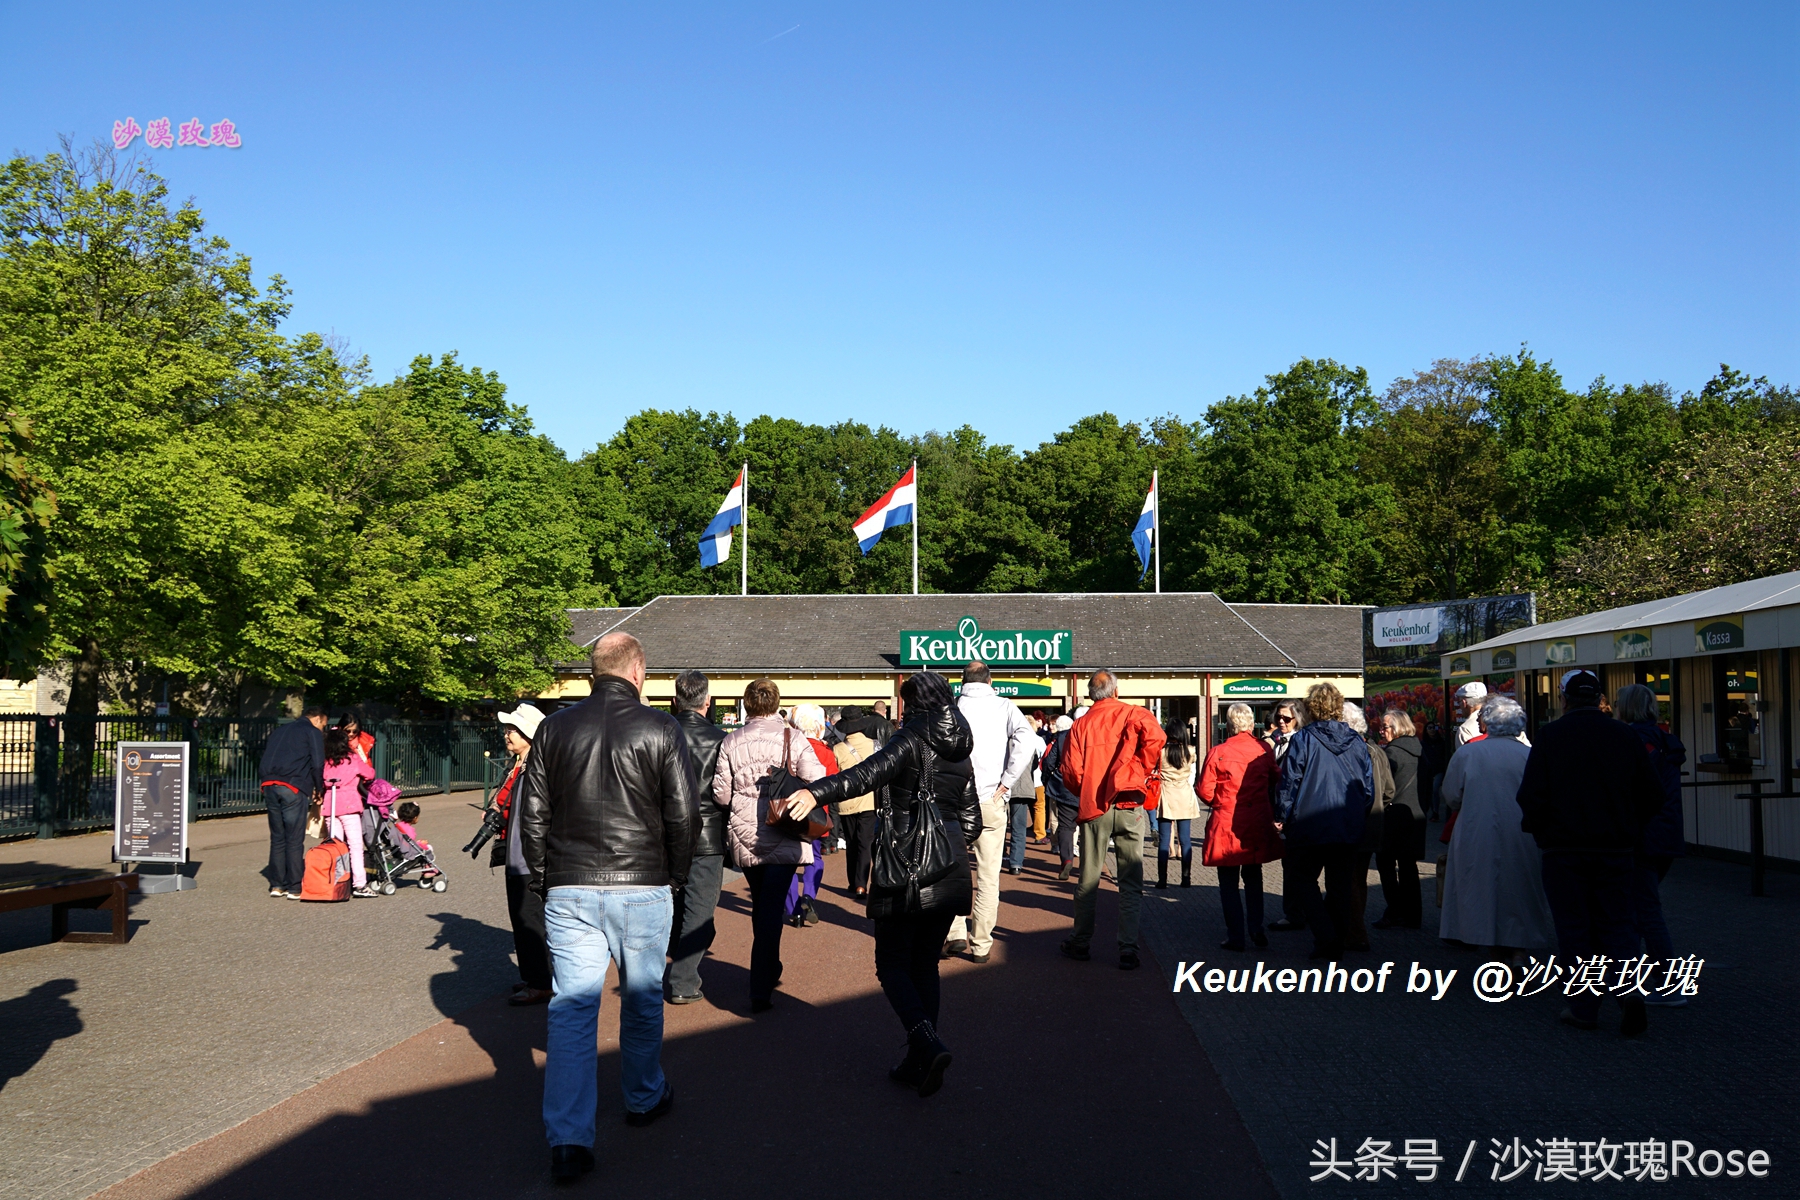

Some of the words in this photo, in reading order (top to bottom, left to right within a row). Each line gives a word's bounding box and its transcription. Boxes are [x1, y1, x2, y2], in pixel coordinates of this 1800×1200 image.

[1381, 621, 1431, 638] Keukenhof
[908, 630, 1063, 661] Keukenhof
[1706, 631, 1731, 646] Kassa
